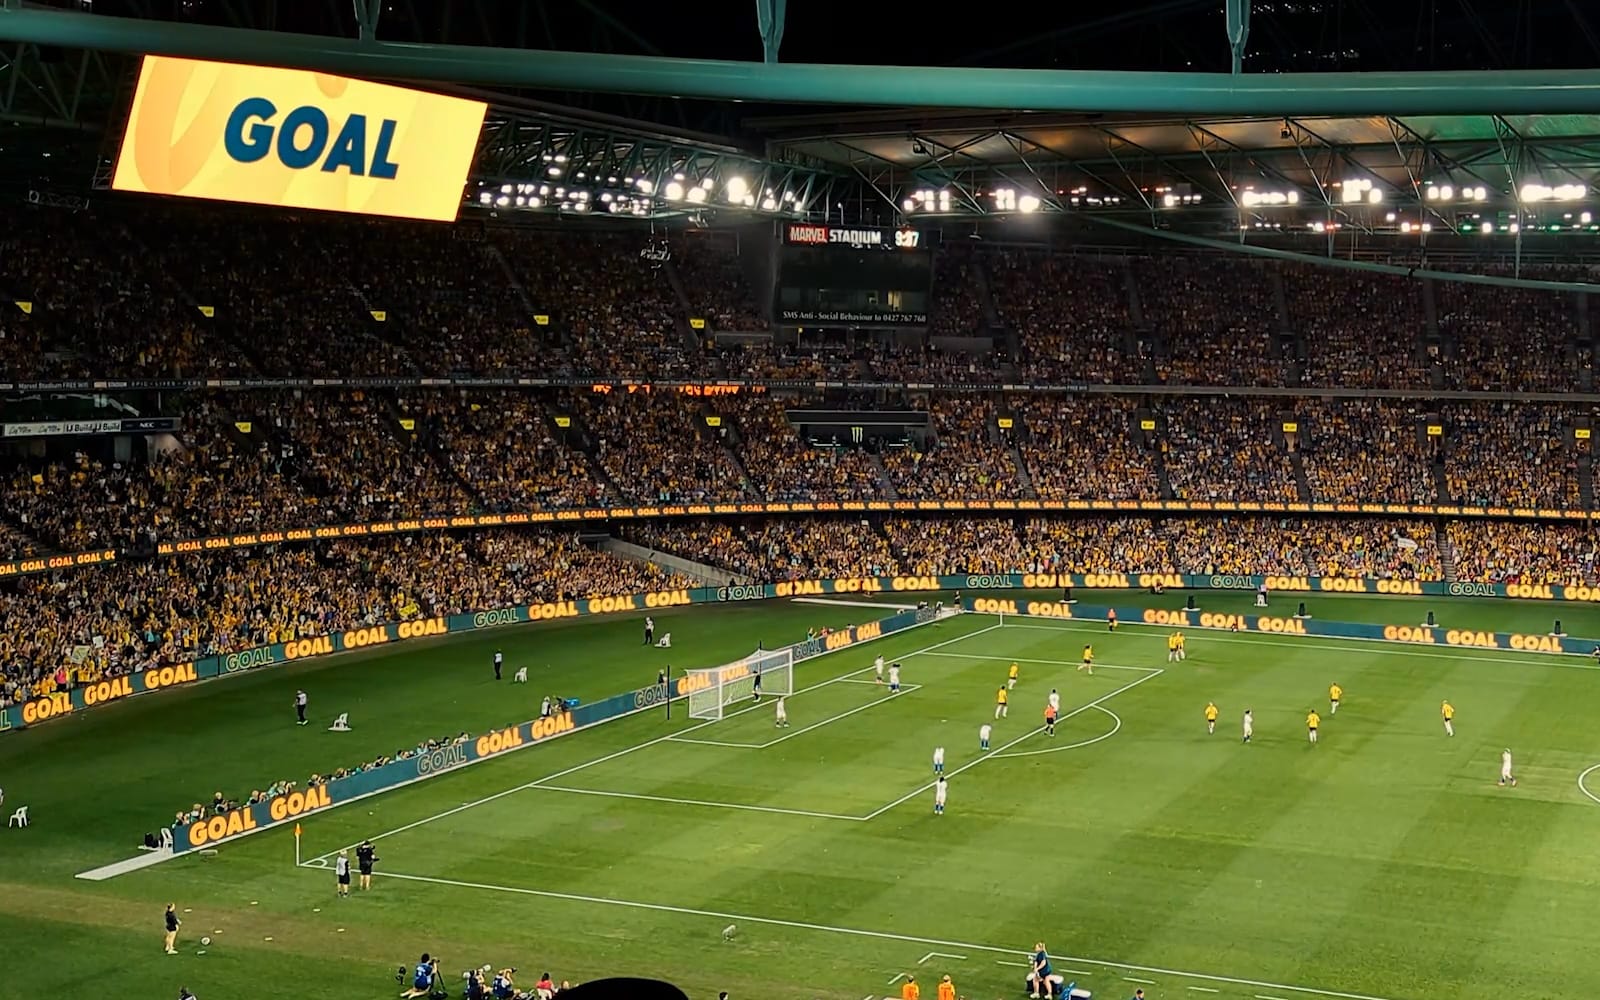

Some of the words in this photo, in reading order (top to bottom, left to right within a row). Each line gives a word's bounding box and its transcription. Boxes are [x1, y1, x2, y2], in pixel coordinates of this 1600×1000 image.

[224, 97, 399, 180] GOAL
[790, 226, 827, 243] MARVEL
[829, 229, 881, 244] STADIUM
[783, 311, 798, 319] SMS
[799, 311, 814, 319] Anti
[818, 311, 838, 320] Social
[840, 312, 873, 321] Behaviour
[177, 542, 202, 551] GOAL
[206, 539, 230, 548] GOAL
[233, 536, 257, 545] GOAL
[261, 533, 284, 542] GOAL
[287, 530, 312, 539] GOAL
[316, 528, 340, 537] GOAL
[344, 526, 367, 535] GOAL
[371, 524, 395, 533] GOAL
[398, 521, 421, 530] GOAL
[424, 520, 448, 528] GOAL
[452, 518, 476, 526] GOAL
[479, 516, 503, 525] GOAL
[505, 515, 529, 523] GOAL
[532, 513, 555, 522] GOAL
[557, 512, 581, 520] GOAL
[584, 510, 608, 518] GOAL
[611, 509, 634, 517] GOAL
[637, 508, 660, 516] GOAL
[663, 507, 685, 515] GOAL
[688, 506, 711, 514] GOAL
[714, 505, 737, 513] GOAL
[741, 504, 763, 512] GOAL
[767, 504, 789, 512] GOAL
[792, 503, 814, 511] GOAL
[21, 561, 45, 571] GOAL
[49, 557, 73, 567] GOAL
[78, 553, 101, 563] GOAL
[23, 692, 73, 723] GOAL
[84, 676, 133, 706] GOAL
[145, 662, 197, 689] GOAL
[226, 646, 274, 672] GOAL
[285, 636, 333, 660] GOAL
[343, 626, 388, 648] GOAL
[398, 617, 447, 639] GOAL
[474, 608, 519, 628] GOAL
[529, 601, 578, 620] GOAL
[588, 595, 635, 614] GOAL
[645, 590, 691, 608] GOAL
[717, 584, 765, 601] GOAL
[834, 577, 882, 593] GOAL
[892, 576, 940, 591] GOAL
[966, 574, 1013, 589] GOAL
[1084, 574, 1129, 588] GOAL
[1139, 574, 1184, 588] GOAL
[1210, 575, 1255, 589] GOAL
[1265, 576, 1311, 590] GOAL
[1320, 578, 1366, 592] GOAL
[1376, 580, 1423, 594] GOAL
[1449, 582, 1496, 596] GOAL
[1506, 584, 1553, 598] GOAL
[974, 598, 1018, 614] GOAL
[1028, 602, 1072, 617] GOAL
[1143, 609, 1189, 625] GOAL
[1200, 613, 1247, 629] GOAL
[1258, 617, 1306, 633] GOAL
[1384, 626, 1434, 643] GOAL
[1446, 630, 1498, 647] GOAL
[1510, 634, 1562, 653] GOAL
[189, 807, 256, 846] GOAL
[270, 784, 331, 820] GOAL
[417, 743, 467, 775] GOAL
[476, 726, 522, 757] GOAL
[531, 711, 574, 740] GOAL
[677, 671, 712, 695] GOAL
[825, 629, 852, 649] GOAL
[856, 621, 881, 640] GOAL
